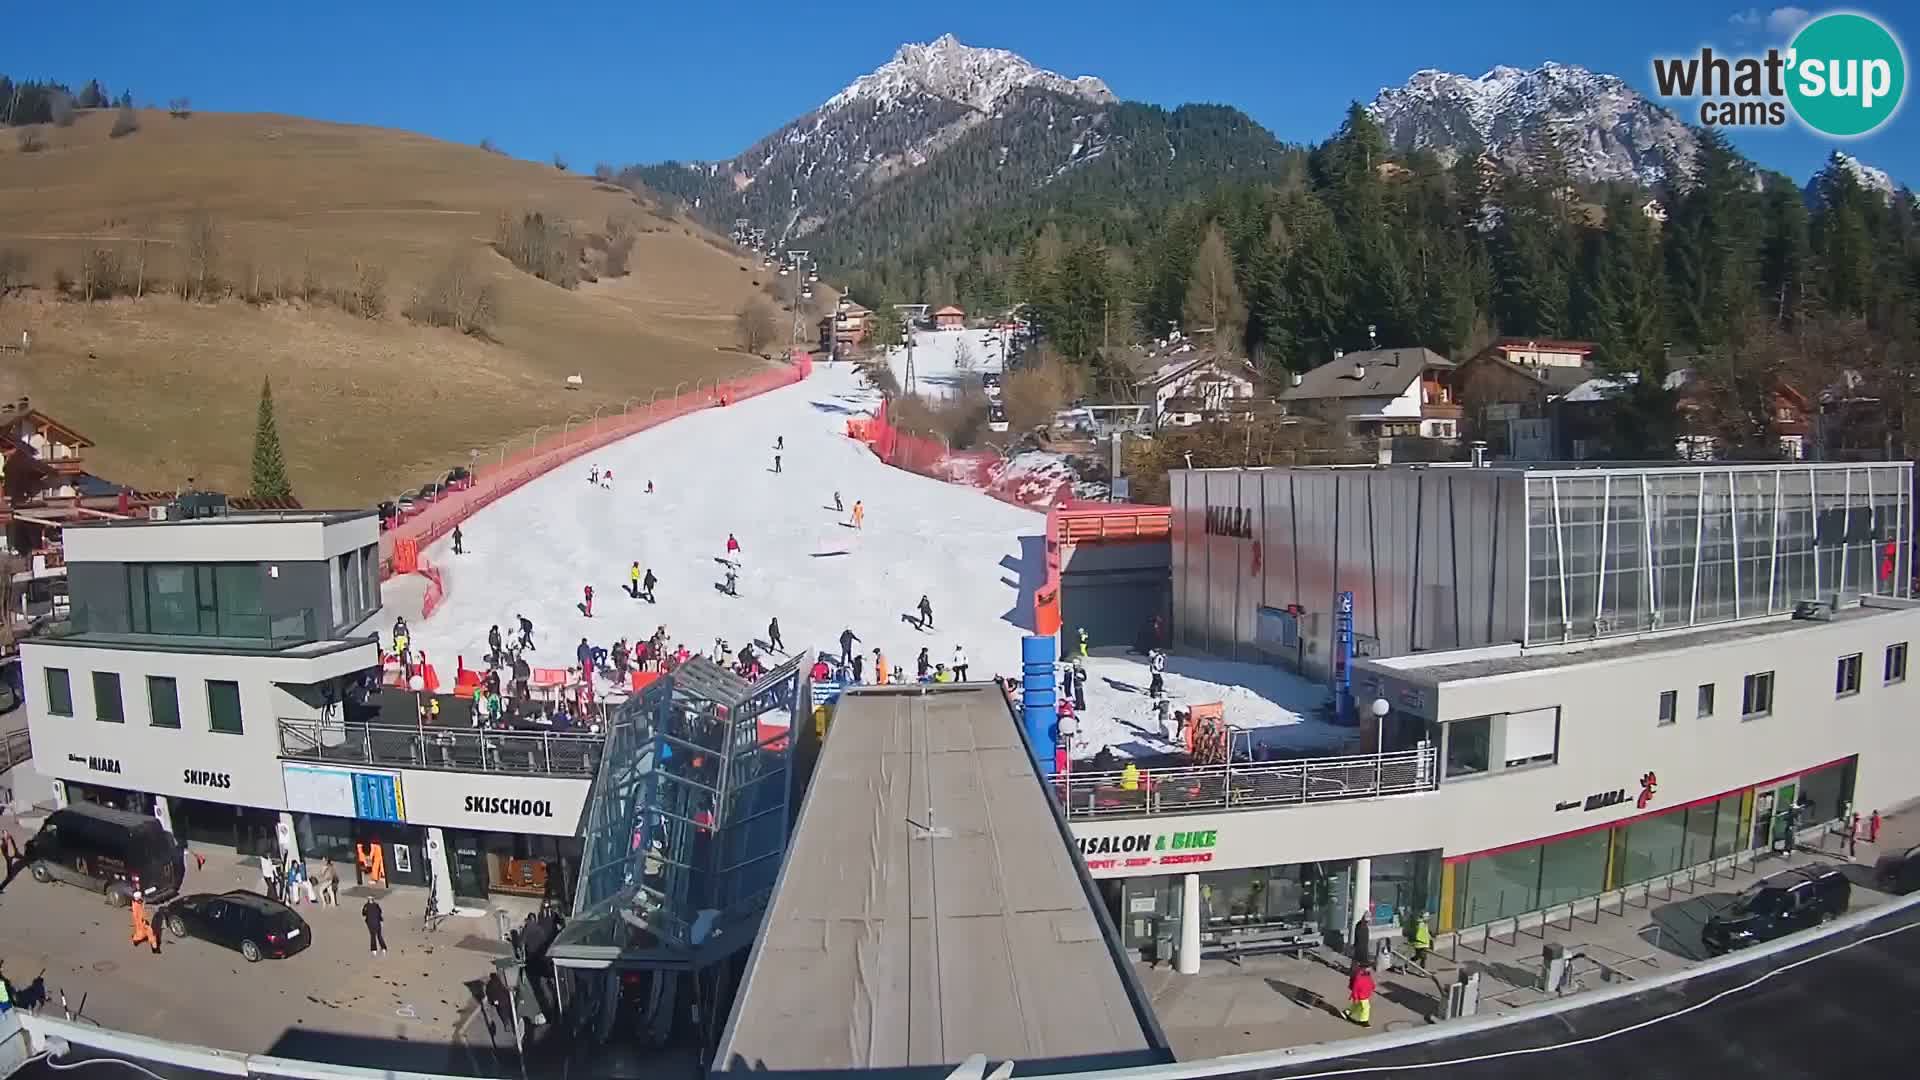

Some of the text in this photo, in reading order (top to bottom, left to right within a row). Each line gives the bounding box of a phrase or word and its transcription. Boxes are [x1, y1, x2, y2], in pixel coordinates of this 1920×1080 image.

[89, 756, 121, 774] MIARA
[184, 769, 231, 789] SKIPASS
[465, 795, 553, 817] SKISCHOOL
[1172, 830, 1217, 849] BIKE
